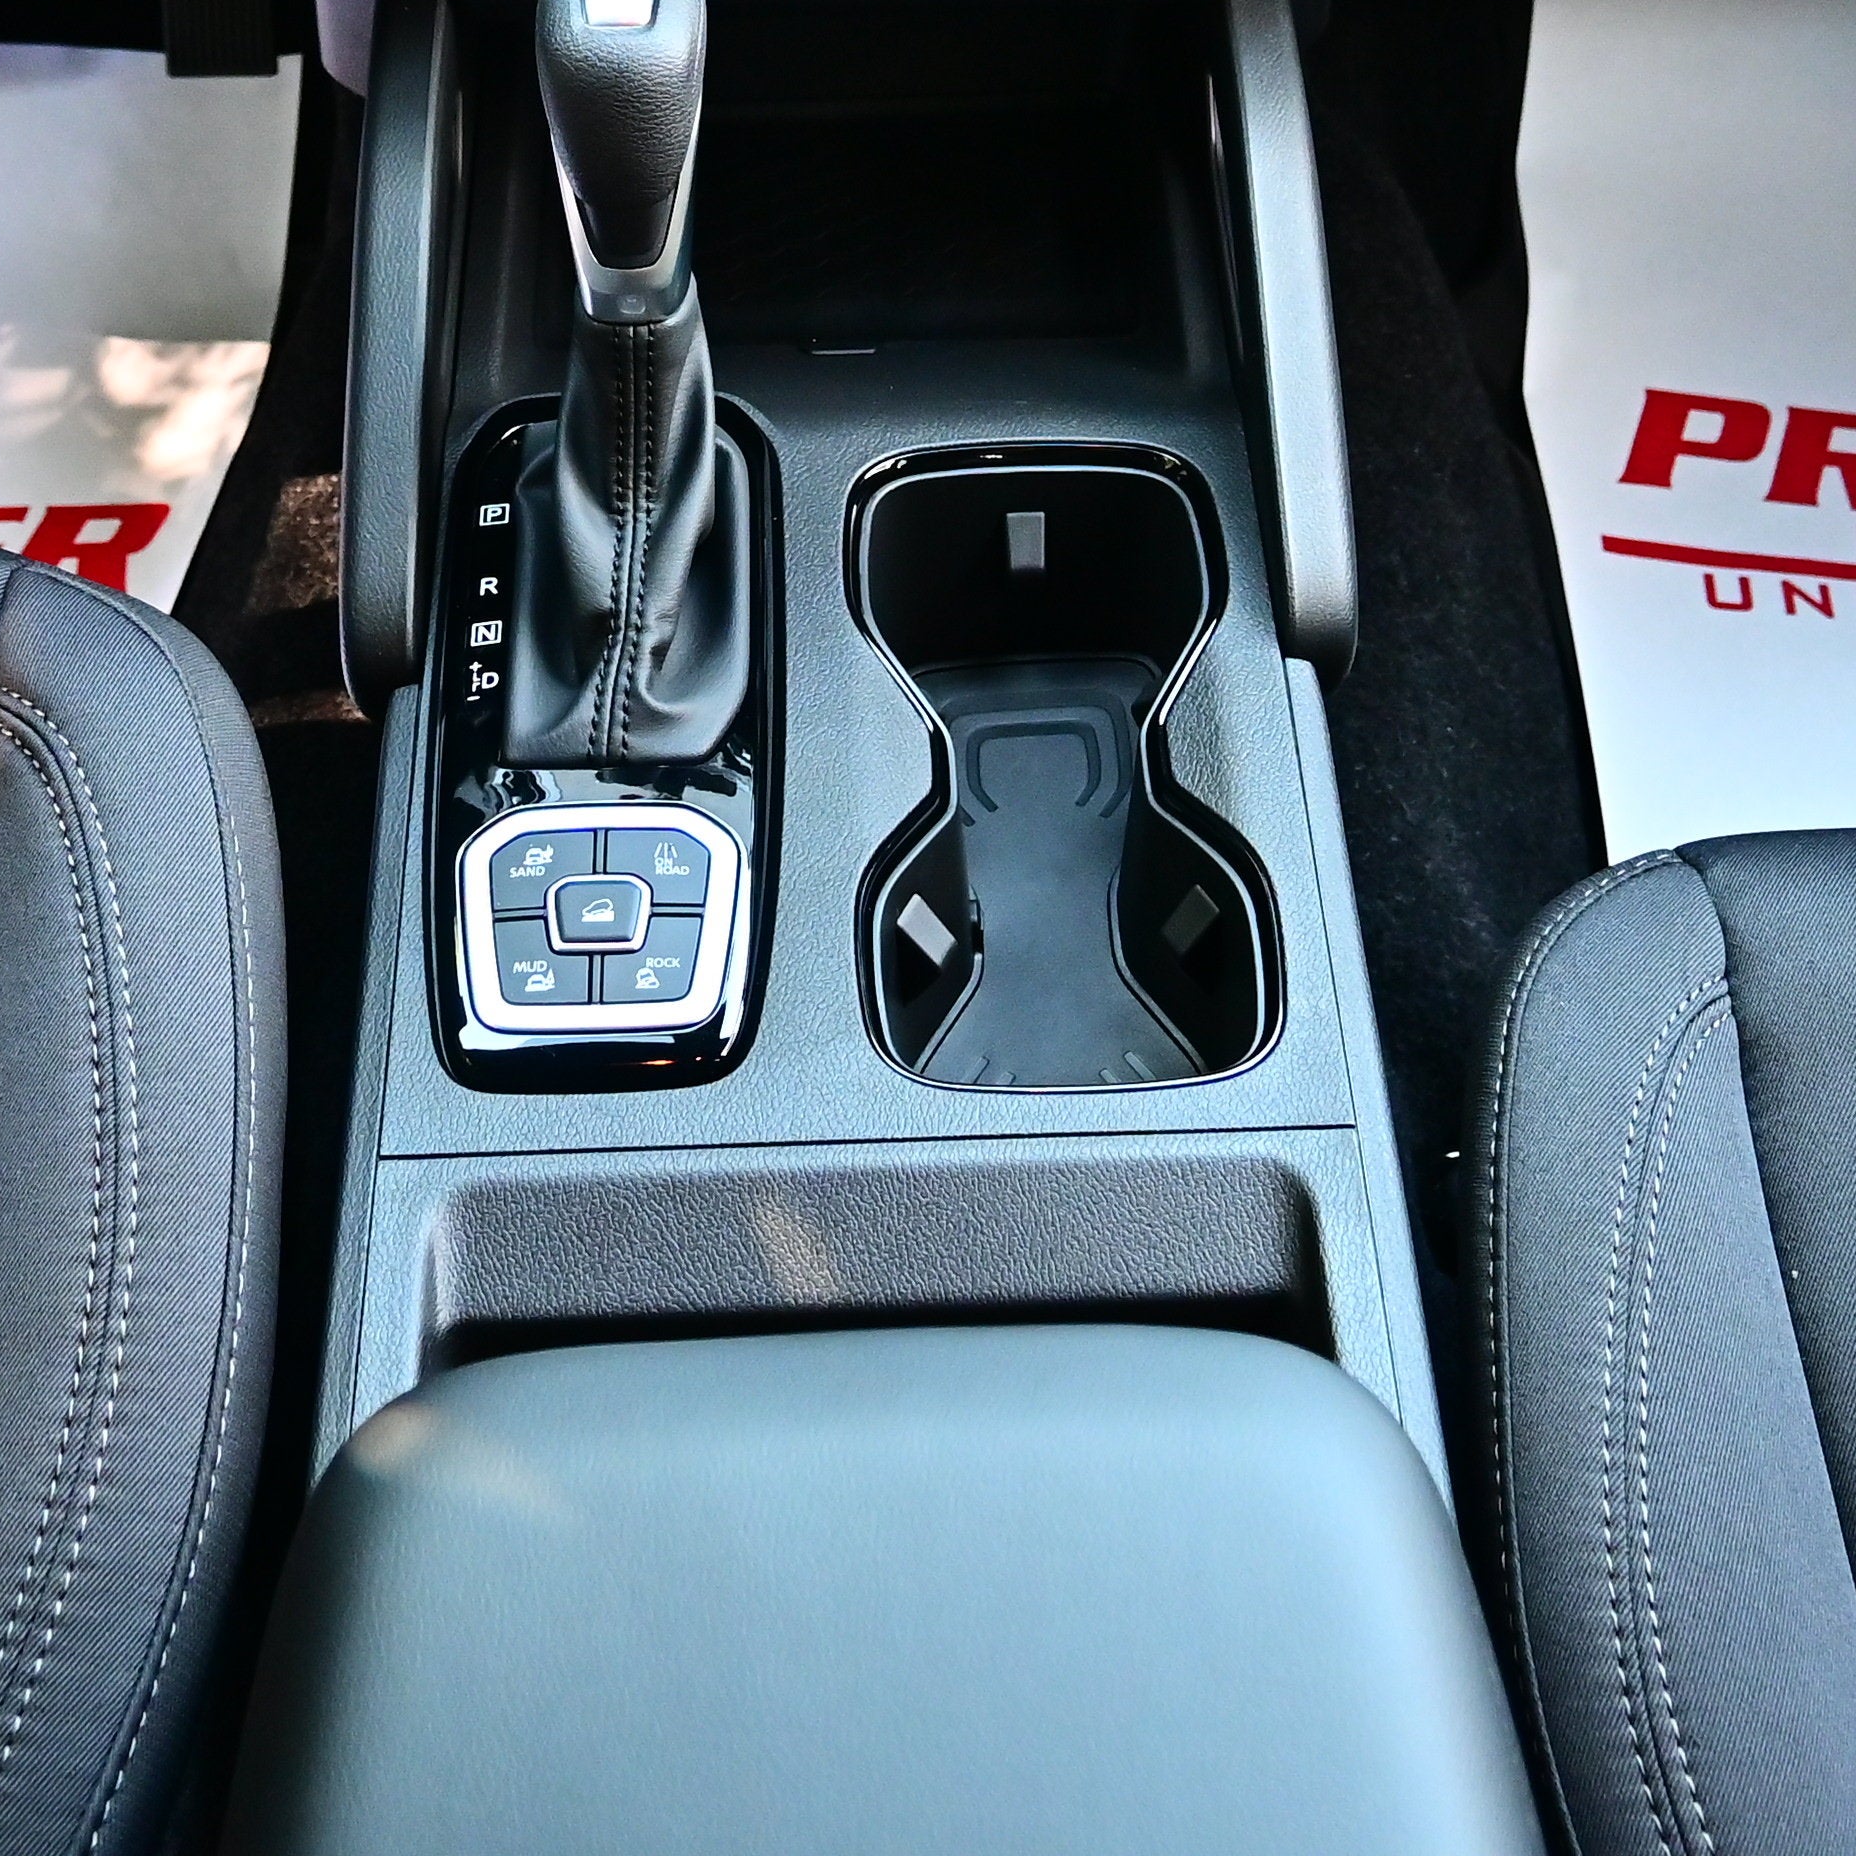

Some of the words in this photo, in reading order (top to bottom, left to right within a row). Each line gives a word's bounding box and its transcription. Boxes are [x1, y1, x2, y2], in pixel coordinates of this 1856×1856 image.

[479, 577, 498, 597] R
[476, 625, 497, 643] N
[481, 671, 500, 690] D
[654, 855, 674, 868] ON
[509, 864, 546, 878] SAND
[655, 863, 690, 877] ROAD
[512, 959, 548, 975] MUD
[645, 955, 681, 970] ROCK
